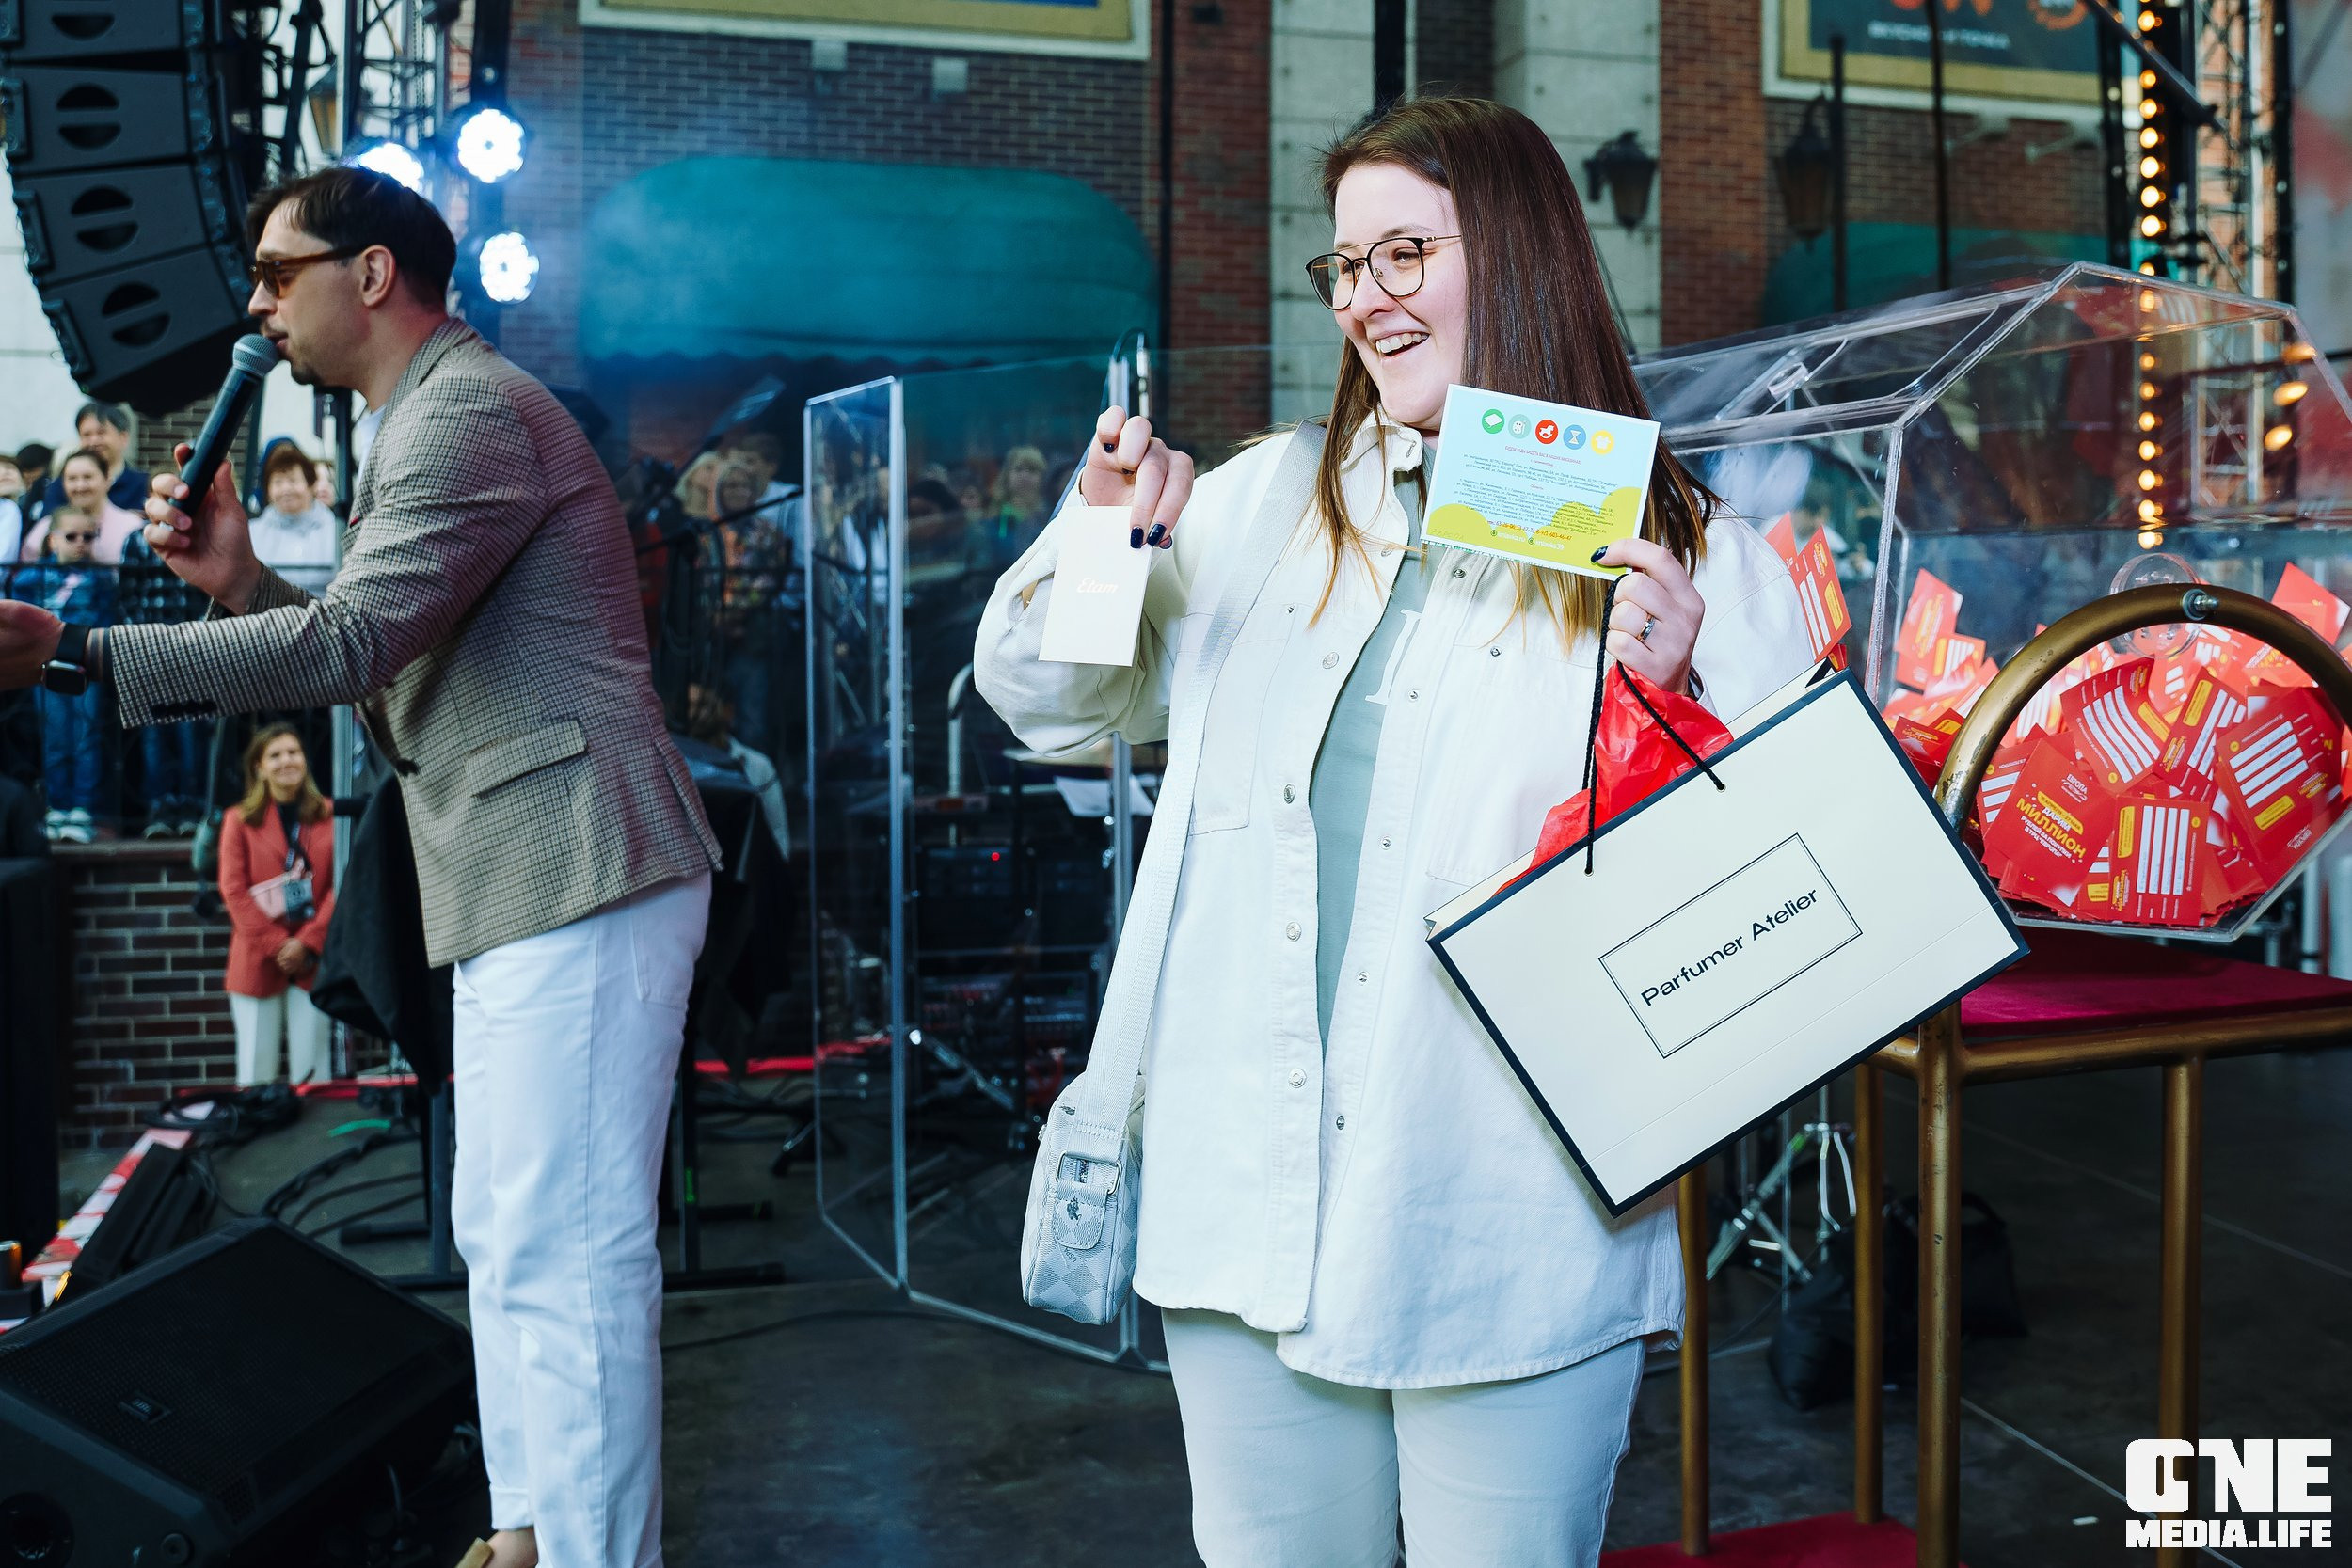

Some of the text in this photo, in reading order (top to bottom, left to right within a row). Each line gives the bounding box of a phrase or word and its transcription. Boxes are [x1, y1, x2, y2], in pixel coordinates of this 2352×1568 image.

[1076, 577, 1119, 594] Etam
[2016, 797, 2087, 858] МИЛЛИОН
[2042, 807, 2072, 832] ДАРИМ
[1641, 889, 1817, 1006] Parfumer Atelier
